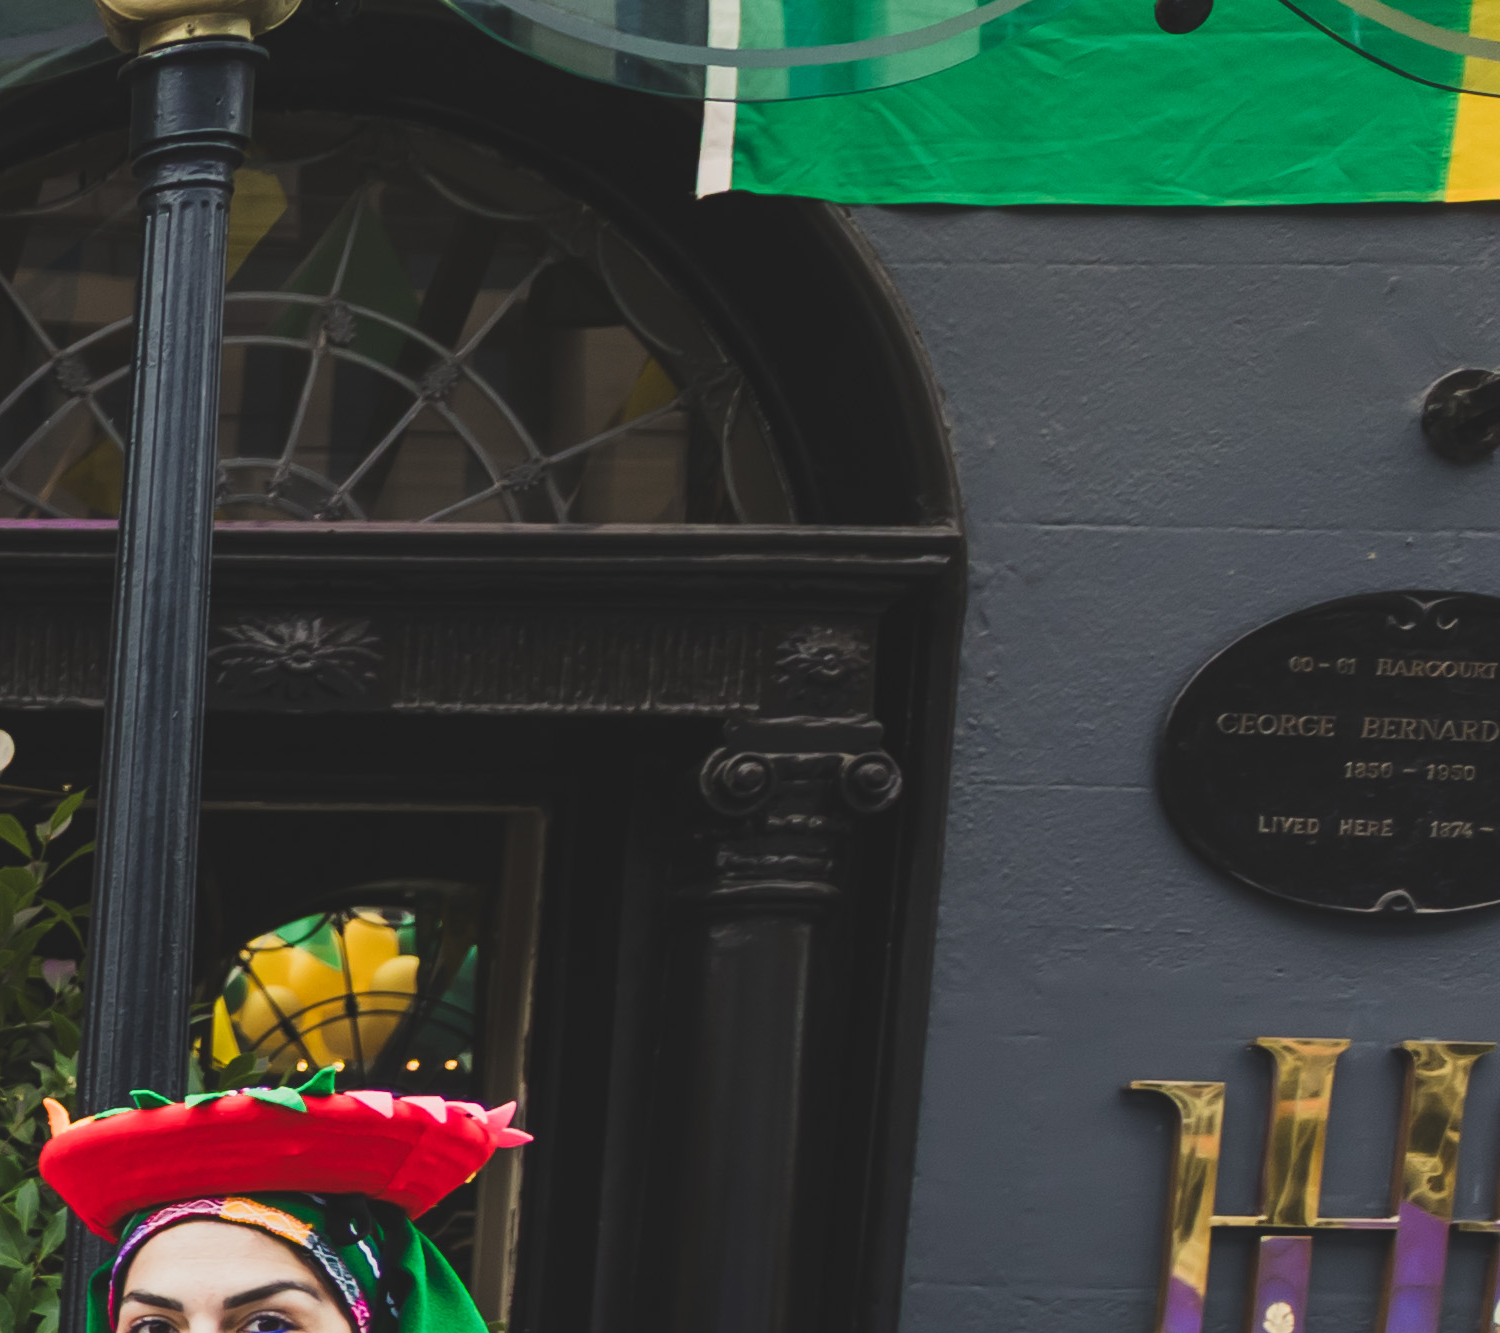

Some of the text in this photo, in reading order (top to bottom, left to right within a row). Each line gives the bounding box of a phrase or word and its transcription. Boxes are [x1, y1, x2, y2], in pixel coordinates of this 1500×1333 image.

[1375, 658, 1499, 679] HARCOURT
[1216, 712, 1500, 742] GEORGE BERNARD
[1425, 763, 1476, 781] 1950
[1258, 815, 1321, 835] LIVED
[1338, 818, 1394, 837] HERE
[1429, 820, 1475, 838] 1874
